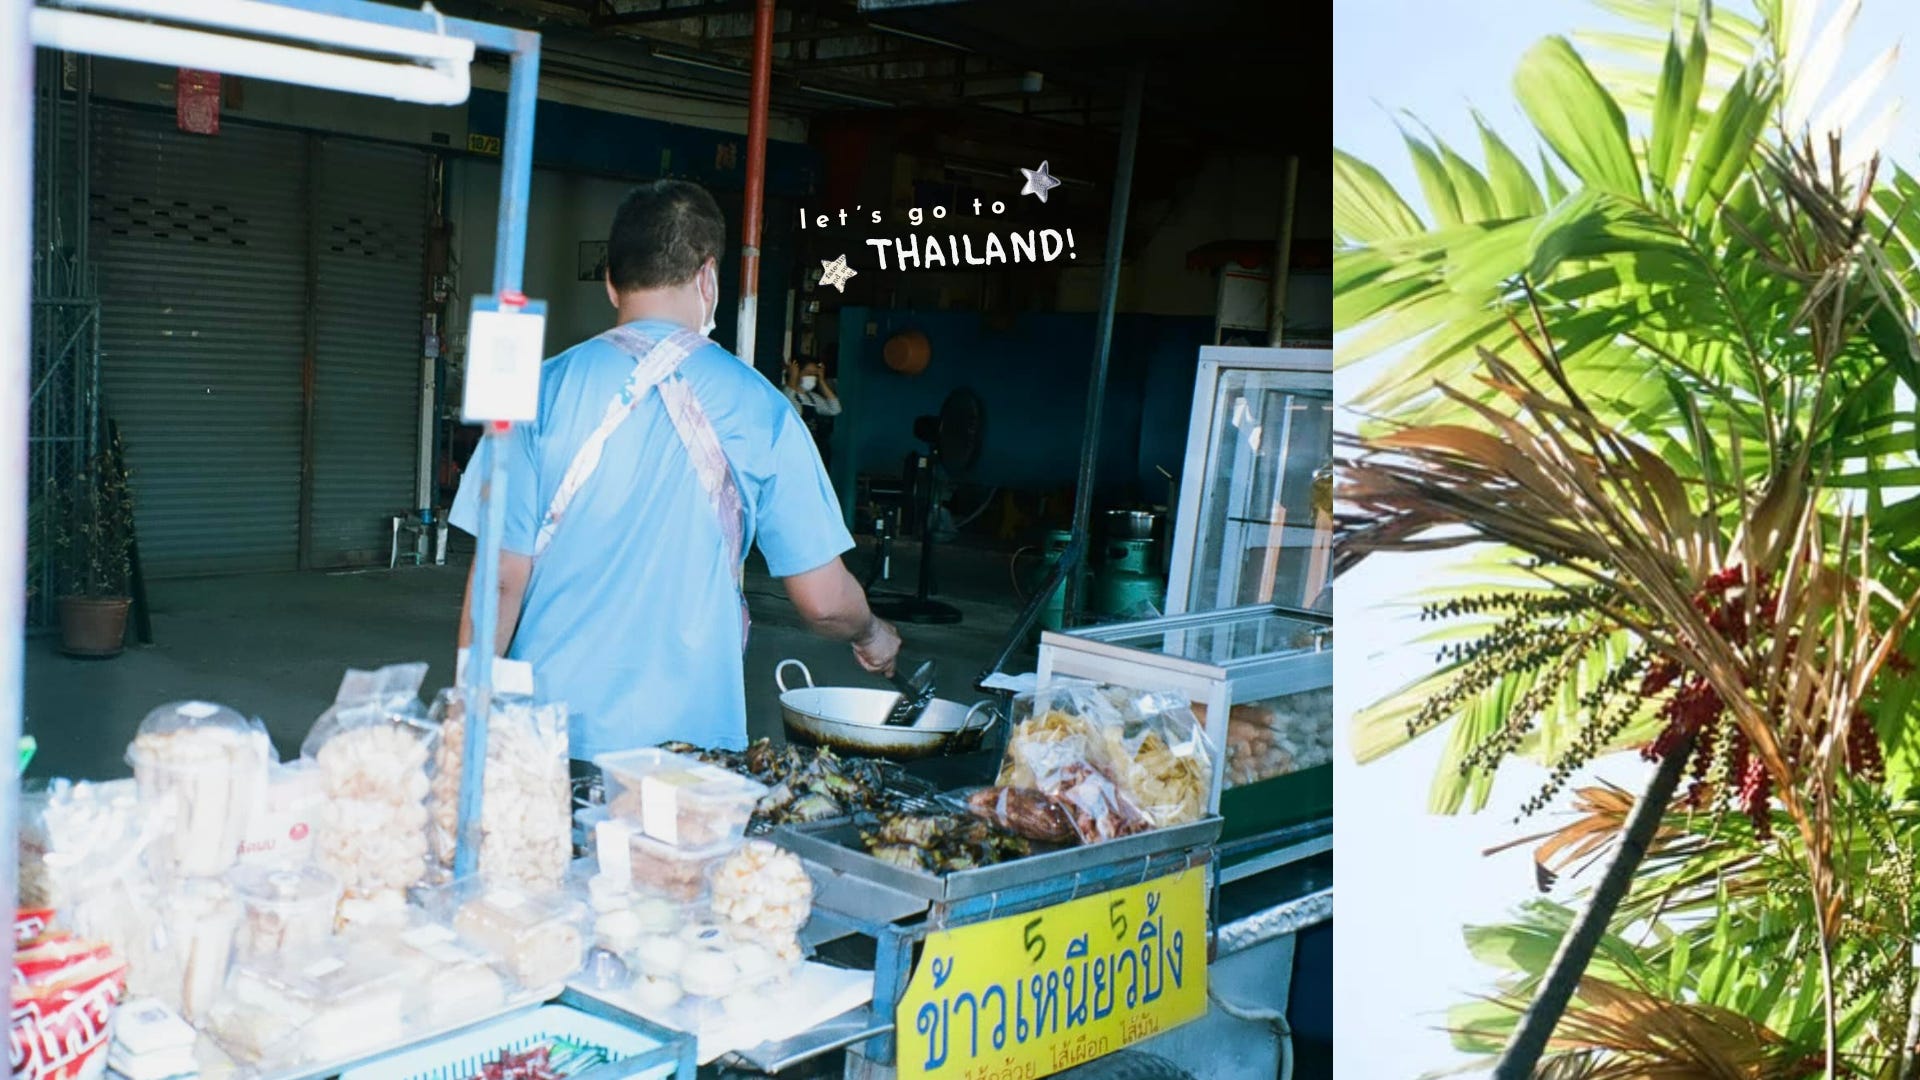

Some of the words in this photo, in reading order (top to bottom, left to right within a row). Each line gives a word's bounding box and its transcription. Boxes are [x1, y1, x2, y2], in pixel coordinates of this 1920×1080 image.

[1024, 917, 1047, 963] 5
[1109, 898, 1129, 941] 5
[916, 891, 1184, 1072] ข้าวเหนียวปิ้ง
[1050, 1033, 1109, 1071] ไส้เผือก
